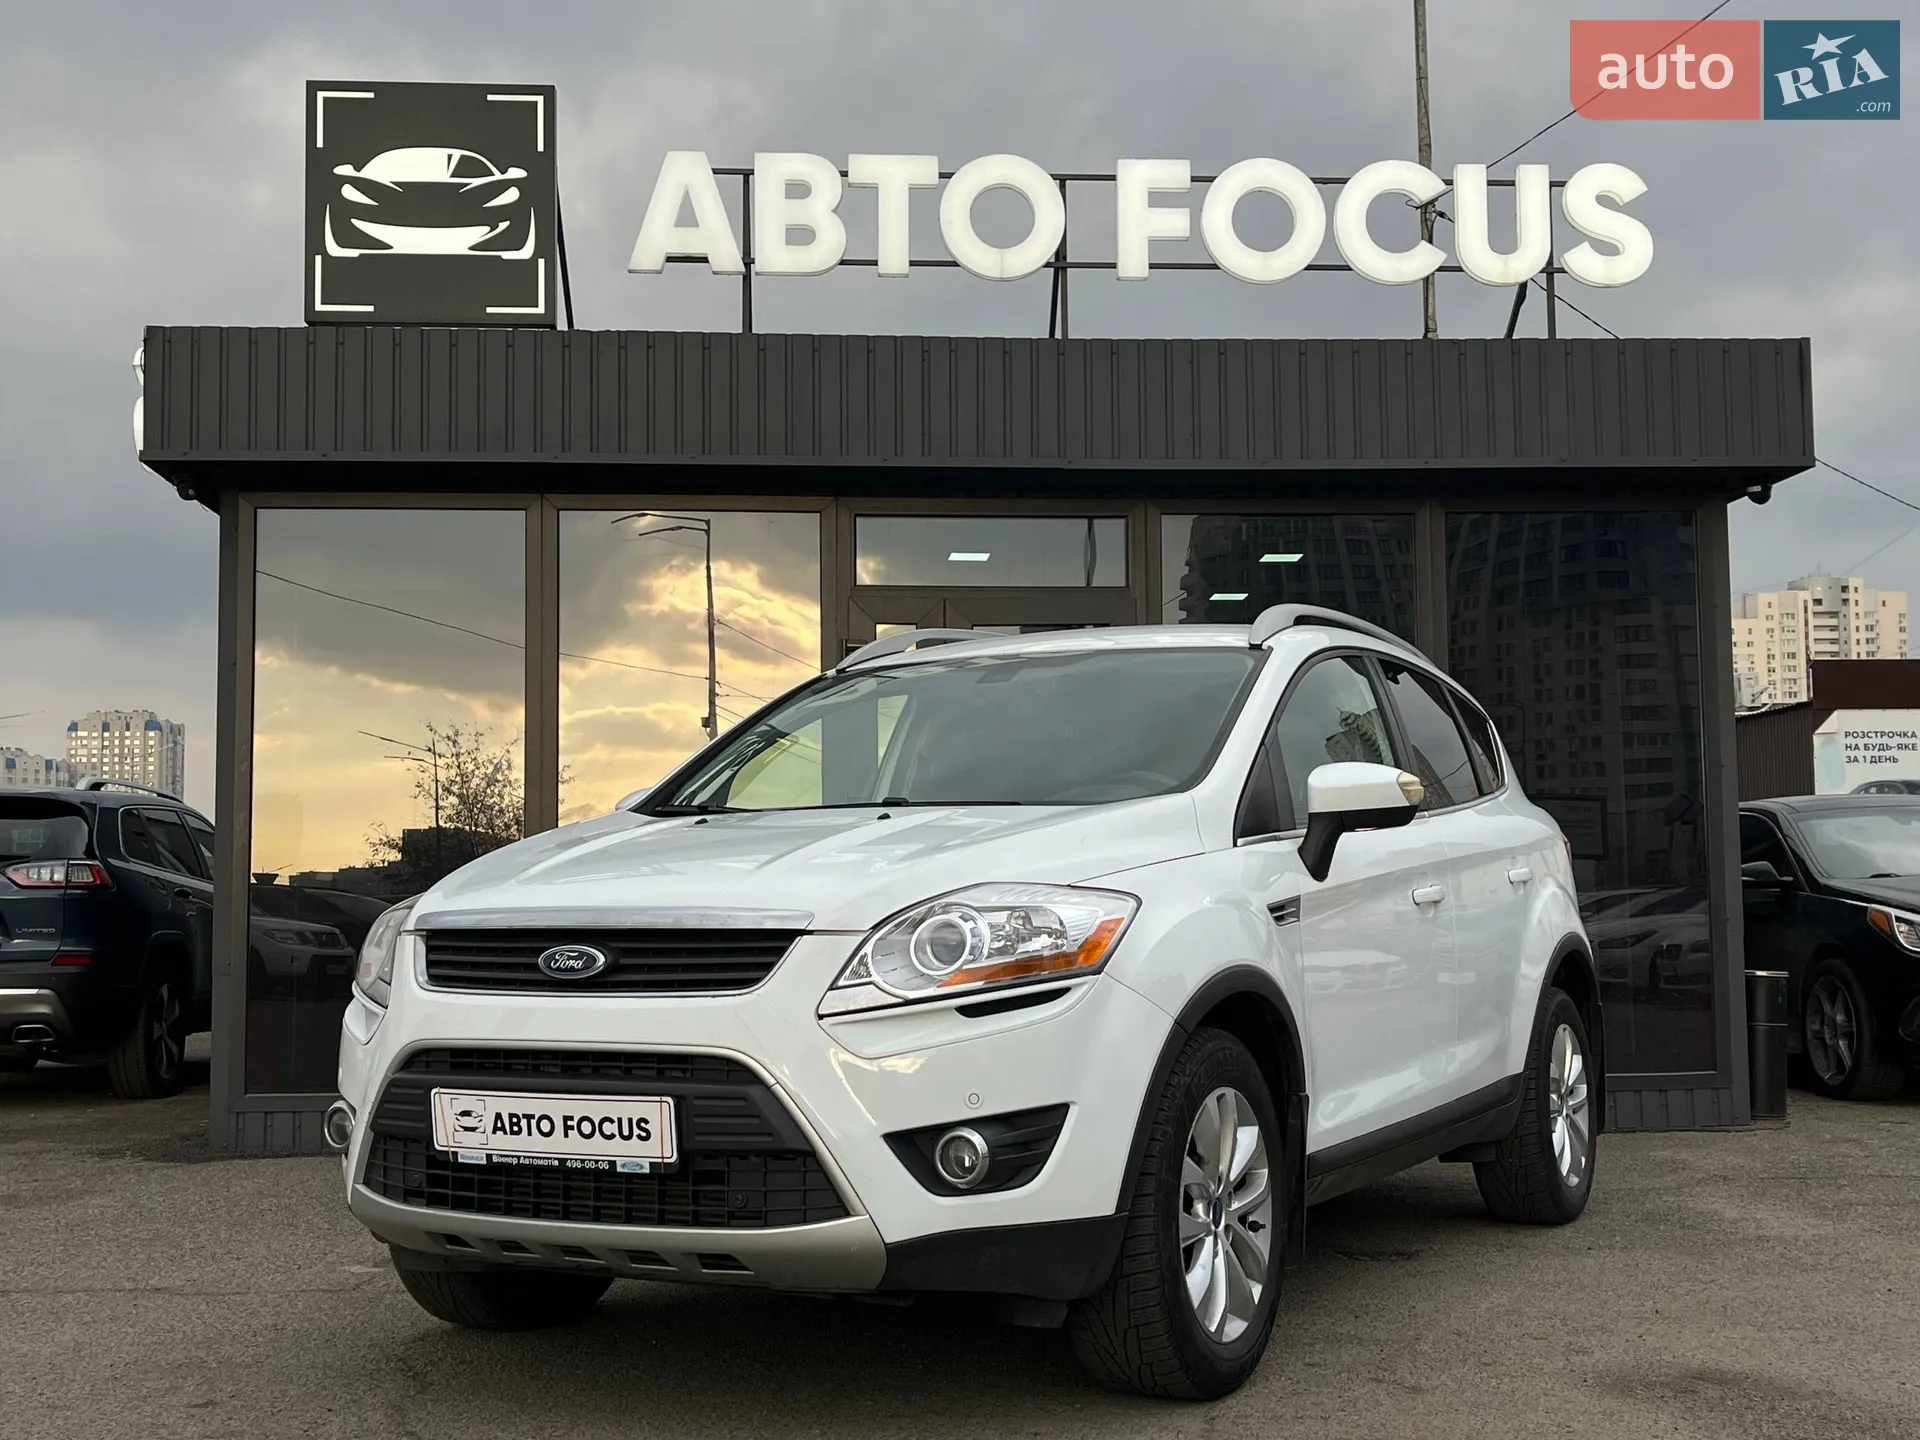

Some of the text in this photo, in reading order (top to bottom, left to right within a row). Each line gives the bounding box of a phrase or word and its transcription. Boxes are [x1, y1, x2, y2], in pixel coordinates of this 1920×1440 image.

[627, 150, 1654, 288] АВТО FOCUS
[1844, 731, 1918, 739] РОЗСТРОЧКА
[1845, 743, 1919, 753] НА БУДЬ-ЯКЕ
[1845, 755, 1860, 764] ЗА
[1869, 755, 1899, 765] ДЕНЬ
[550, 951, 587, 969] Ford
[491, 1112, 652, 1142] АВТО FOCUS
